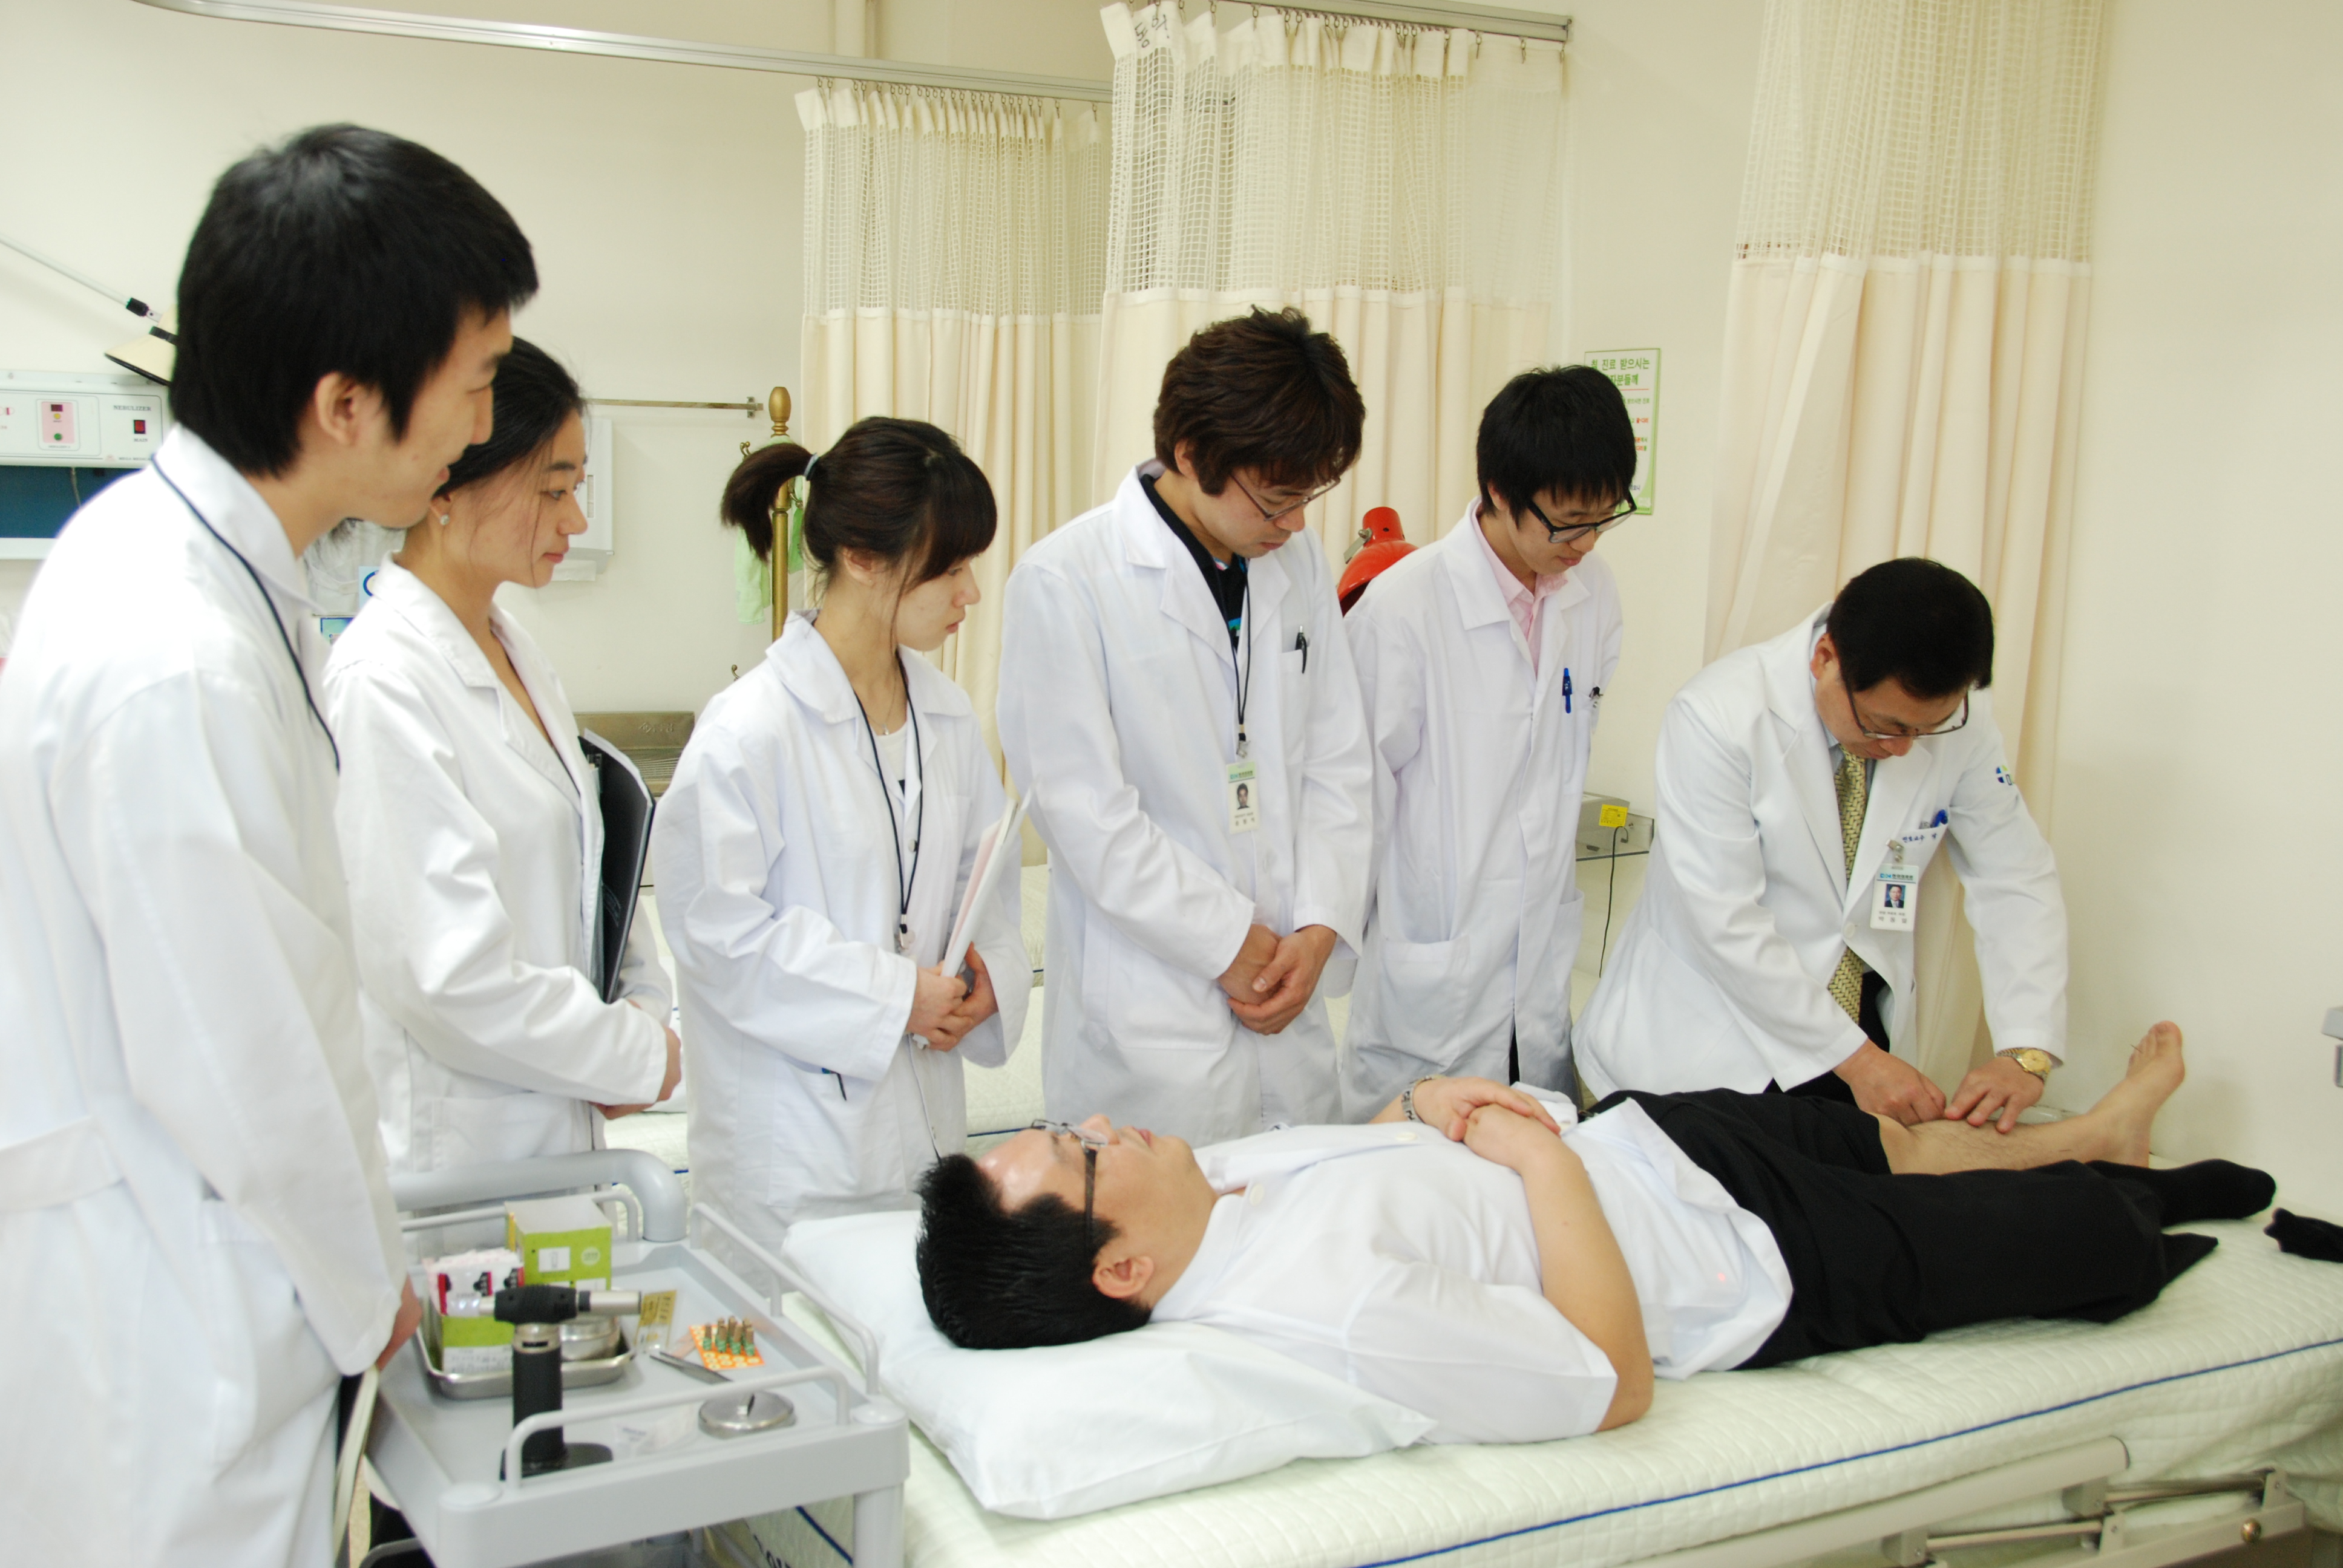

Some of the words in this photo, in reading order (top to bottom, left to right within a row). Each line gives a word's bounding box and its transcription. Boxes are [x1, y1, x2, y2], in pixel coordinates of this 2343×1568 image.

[1602, 359, 1616, 371] 진료
[1620, 357, 1650, 370] 받으시는
[1607, 373, 1639, 386] 자분들께
